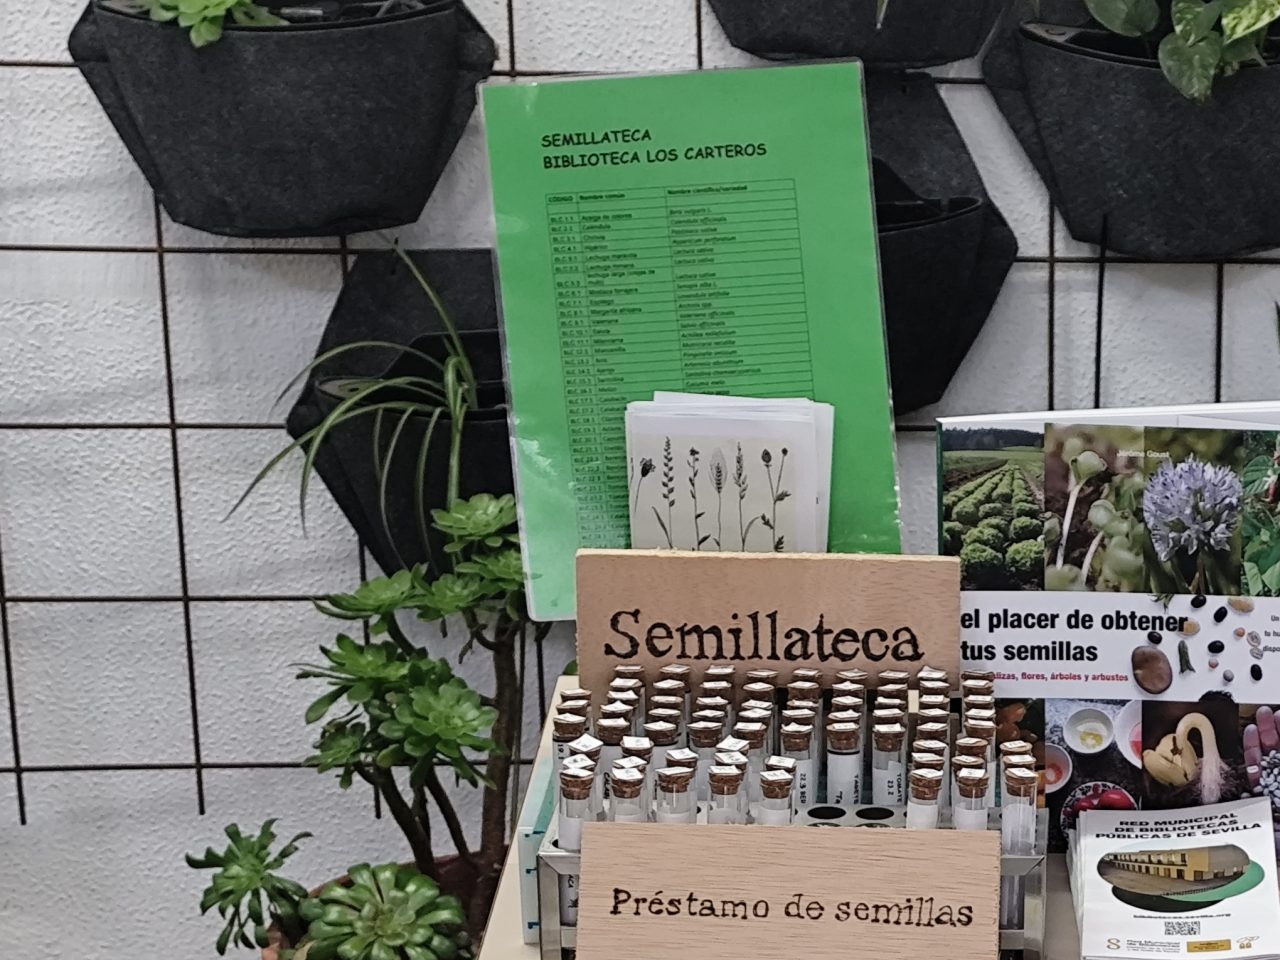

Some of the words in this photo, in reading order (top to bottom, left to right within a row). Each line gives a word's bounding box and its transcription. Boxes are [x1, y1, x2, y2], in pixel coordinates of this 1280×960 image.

[541, 129, 651, 147] SEMILLATECA
[544, 151, 640, 169] BIBLIOTECA
[647, 149, 678, 163] LOS
[685, 144, 767, 160] CARTEROS
[960, 609, 980, 630] el
[986, 610, 1059, 634] placer
[1066, 610, 1094, 630] de
[1101, 611, 1188, 632] obtener
[604, 608, 925, 662] Semillateca
[960, 642, 996, 661] tus
[1004, 641, 1098, 661] semillas
[1021, 672, 1047, 681] flores,
[1050, 672, 1082, 680] árboles
[1084, 674, 1089, 682] y
[1092, 673, 1128, 681] arbustos
[1142, 819, 1238, 832] BIBLIOTECAS
[1154, 813, 1238, 826] MUNICIPAL
[1201, 823, 1262, 836] SEVILLA
[609, 887, 770, 919] Préstamo
[783, 893, 825, 921] de
[834, 897, 974, 927] semillas
